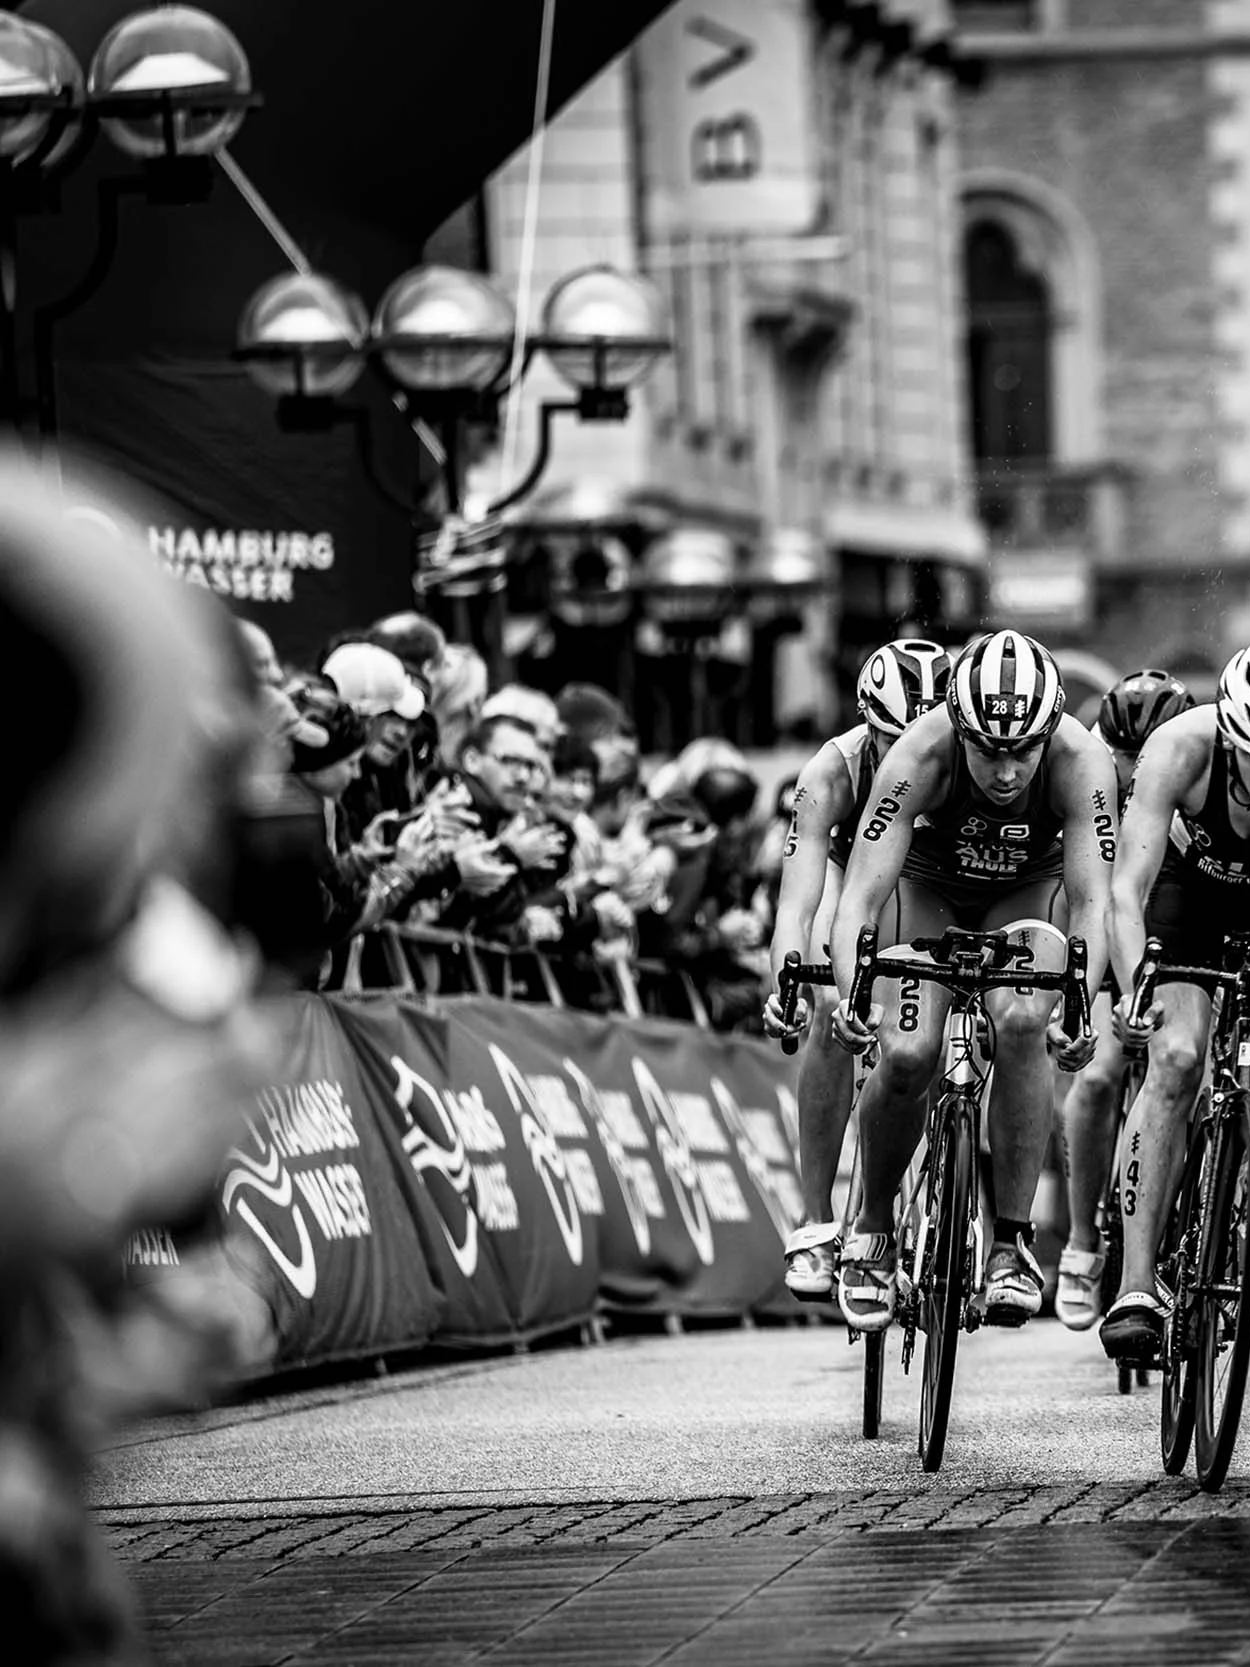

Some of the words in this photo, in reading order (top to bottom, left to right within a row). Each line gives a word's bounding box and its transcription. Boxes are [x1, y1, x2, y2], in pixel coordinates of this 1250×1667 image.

[148, 526, 334, 570] HAMBURG
[914, 703, 930, 718] 15
[991, 700, 1008, 715] 28
[862, 796, 903, 843] 28
[1092, 813, 1117, 864] 28
[961, 856, 1017, 873] THULE
[898, 976, 921, 1032] 28
[1124, 1159, 1140, 1217] 43
